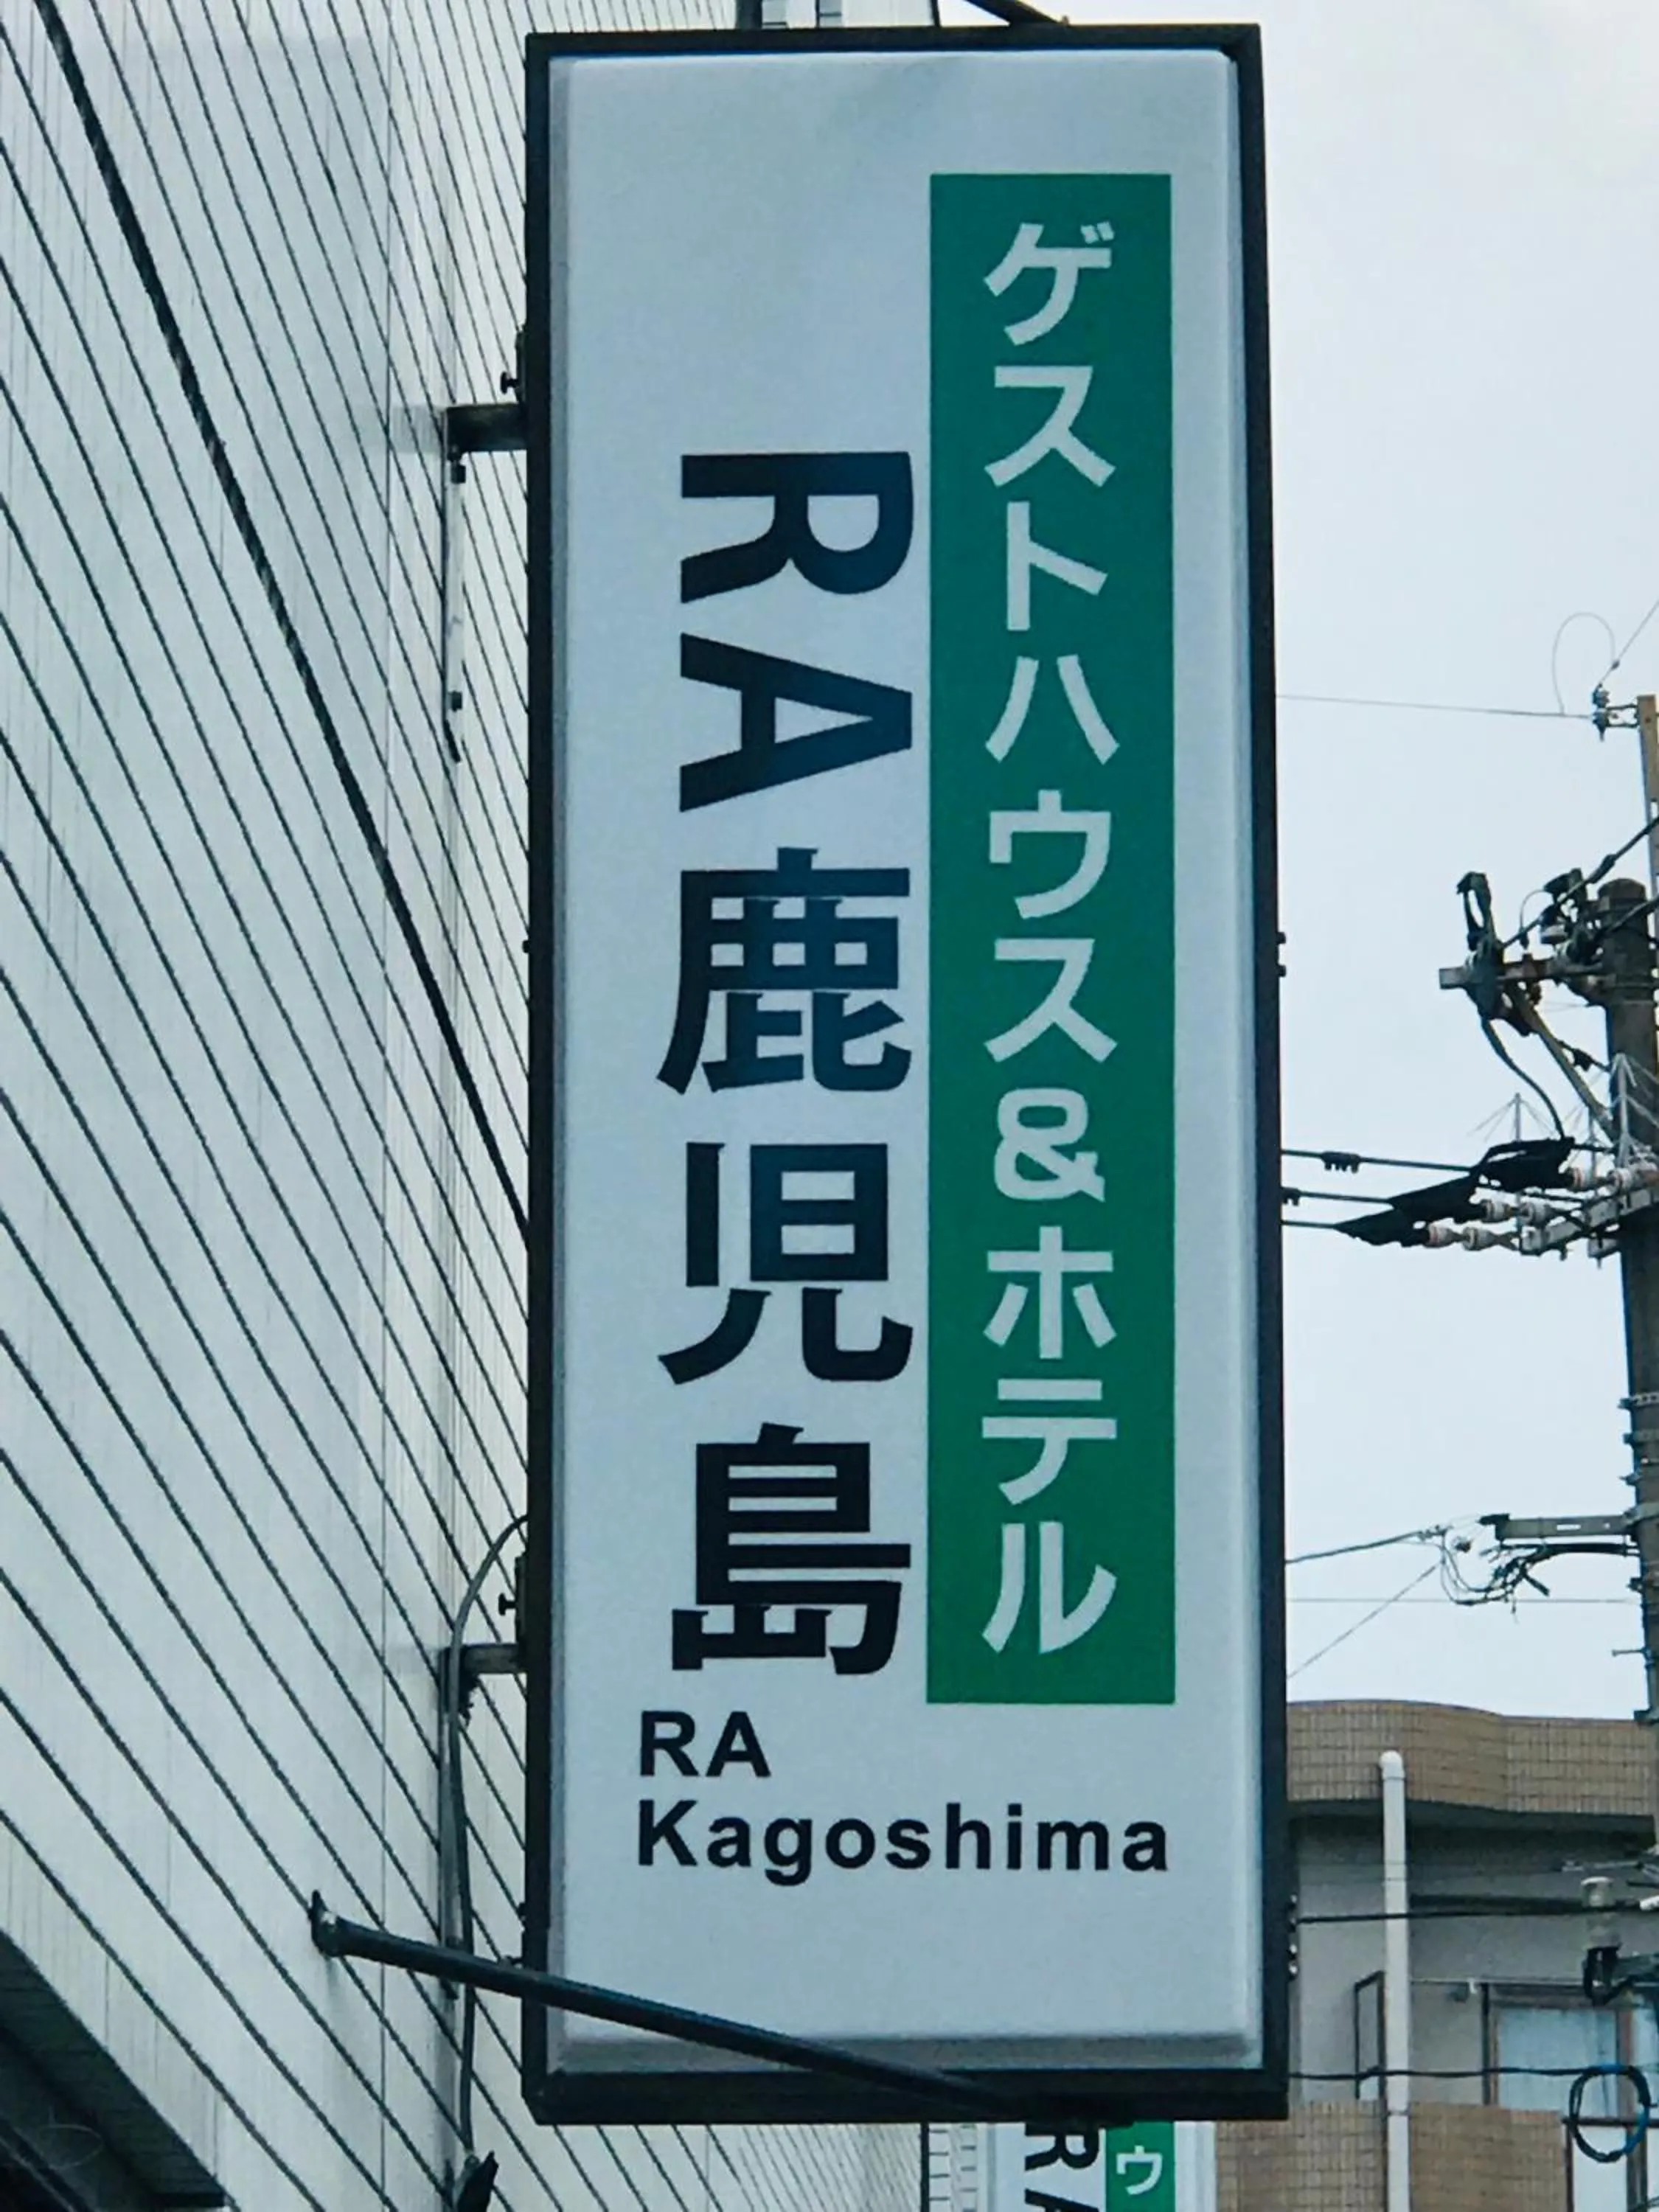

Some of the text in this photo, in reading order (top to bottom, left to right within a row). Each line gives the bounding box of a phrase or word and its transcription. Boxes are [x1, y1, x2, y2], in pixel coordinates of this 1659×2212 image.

[656, 451, 914, 1675] RA鹿児島
[983, 221, 1119, 1653] ゲストハウス&ホテル
[639, 1711, 771, 1778] RA
[639, 1798, 1167, 1886] Kagoshima
